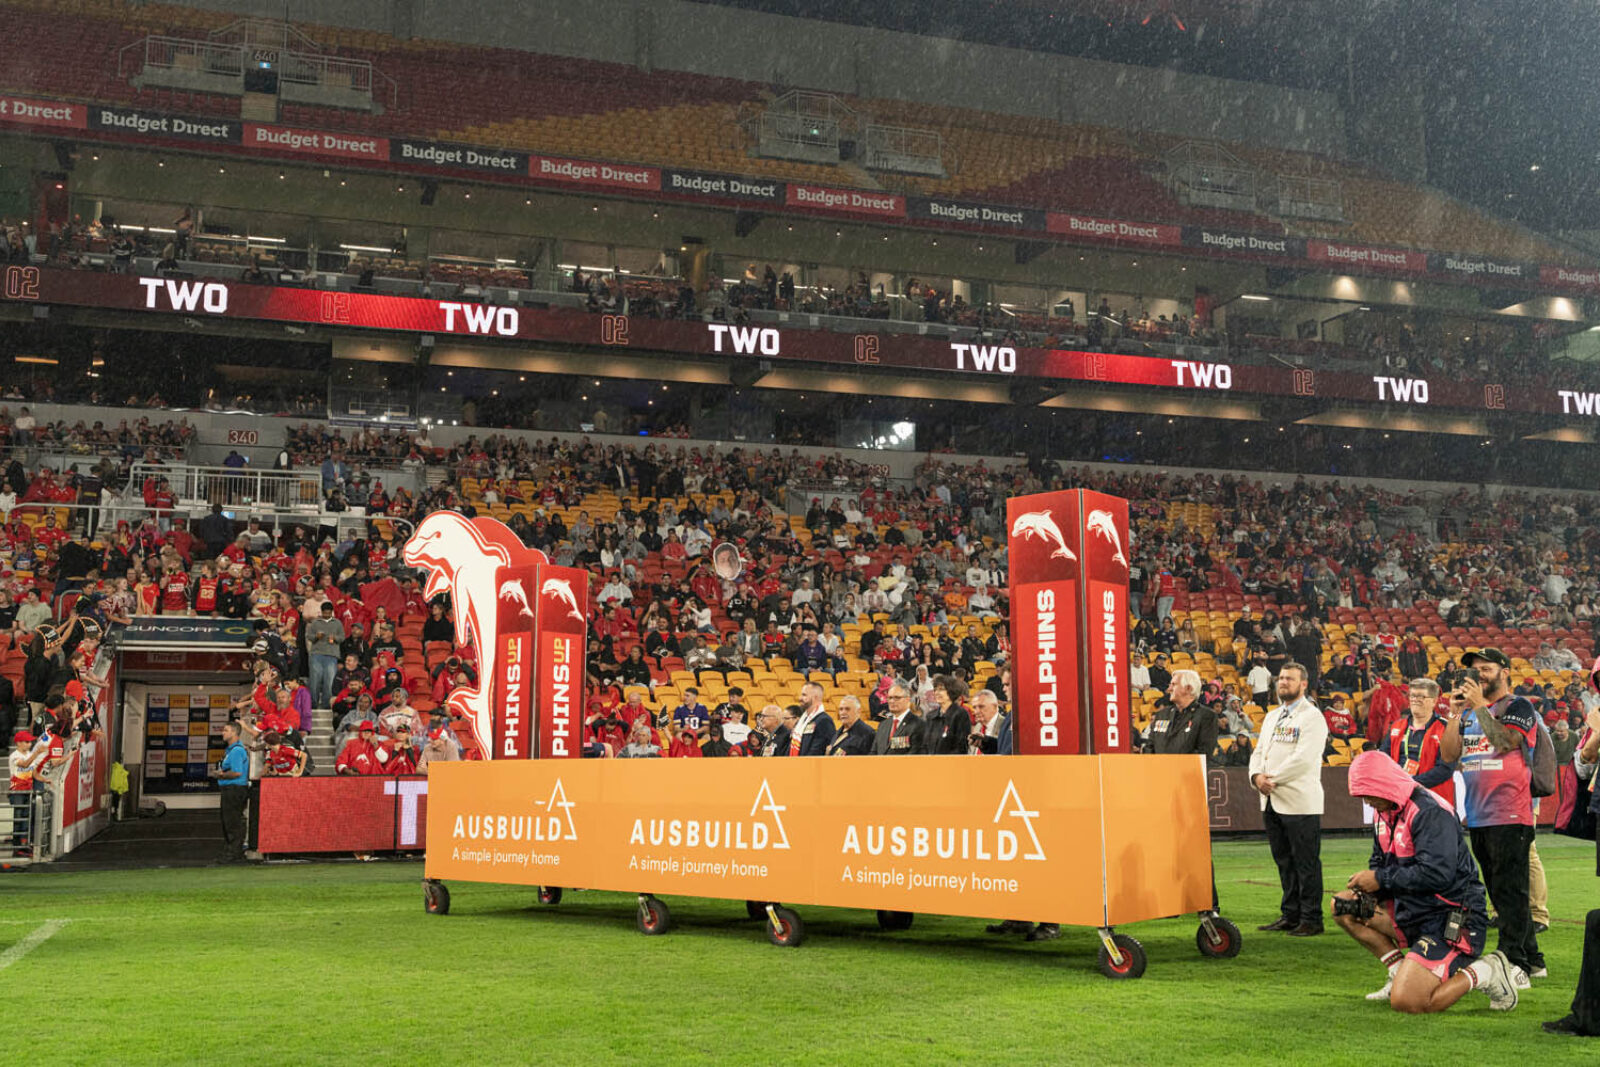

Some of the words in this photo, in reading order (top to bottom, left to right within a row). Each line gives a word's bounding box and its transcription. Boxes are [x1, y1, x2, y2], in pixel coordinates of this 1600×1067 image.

[13, 101, 72, 121] Direct
[101, 110, 168, 132] Budget
[173, 119, 228, 138] Direct
[256, 128, 320, 149] Budget
[324, 135, 376, 154] Direct
[402, 144, 462, 164] Budget
[466, 152, 516, 169] Direct
[541, 160, 597, 180] Budget
[602, 167, 649, 184] Direct
[672, 174, 726, 193] Budget
[730, 181, 775, 198] Direct
[797, 188, 848, 206] Budget
[852, 195, 895, 211] Direct
[930, 203, 979, 220] Budget
[982, 209, 1023, 224] Direct
[1070, 218, 1116, 234] Budget
[1119, 224, 1158, 238] Direct
[1202, 232, 1246, 249] Budget
[1249, 237, 1286, 251] Direct
[1327, 245, 1369, 260] Budget
[1372, 251, 1406, 264] Direct
[1446, 258, 1486, 273] Budget
[1488, 262, 1521, 276] Direct
[1558, 271, 1595, 284] Budget
[5, 266, 40, 299] 02
[139, 277, 228, 314] TWO
[440, 302, 519, 336] TWO
[601, 315, 629, 345] 02
[708, 324, 780, 356] TWO
[854, 334, 880, 364] 02
[951, 343, 1016, 373] TWO
[1172, 360, 1232, 389] TWO
[1293, 369, 1315, 395] 02
[1374, 376, 1429, 404] TWO
[1485, 384, 1505, 409] 02
[229, 431, 257, 445] 340
[126, 625, 220, 633] SUNCORP
[1037, 589, 1058, 747] DOLPHINS
[1103, 590, 1119, 747] DOLPHINS
[453, 815, 561, 841] AUSBUILD
[630, 819, 768, 850] AUSBUILD
[842, 824, 1018, 861] AUSBUILD
[452, 847, 459, 860] A
[461, 848, 491, 864] simple
[493, 849, 529, 867] journey
[531, 850, 560, 865] home
[629, 855, 638, 870] A
[640, 855, 679, 875] simple
[682, 857, 728, 878] journey
[731, 859, 768, 877] home
[841, 865, 853, 881] A
[856, 866, 905, 887] simple
[907, 868, 968, 893] journey
[972, 872, 1018, 892] home
